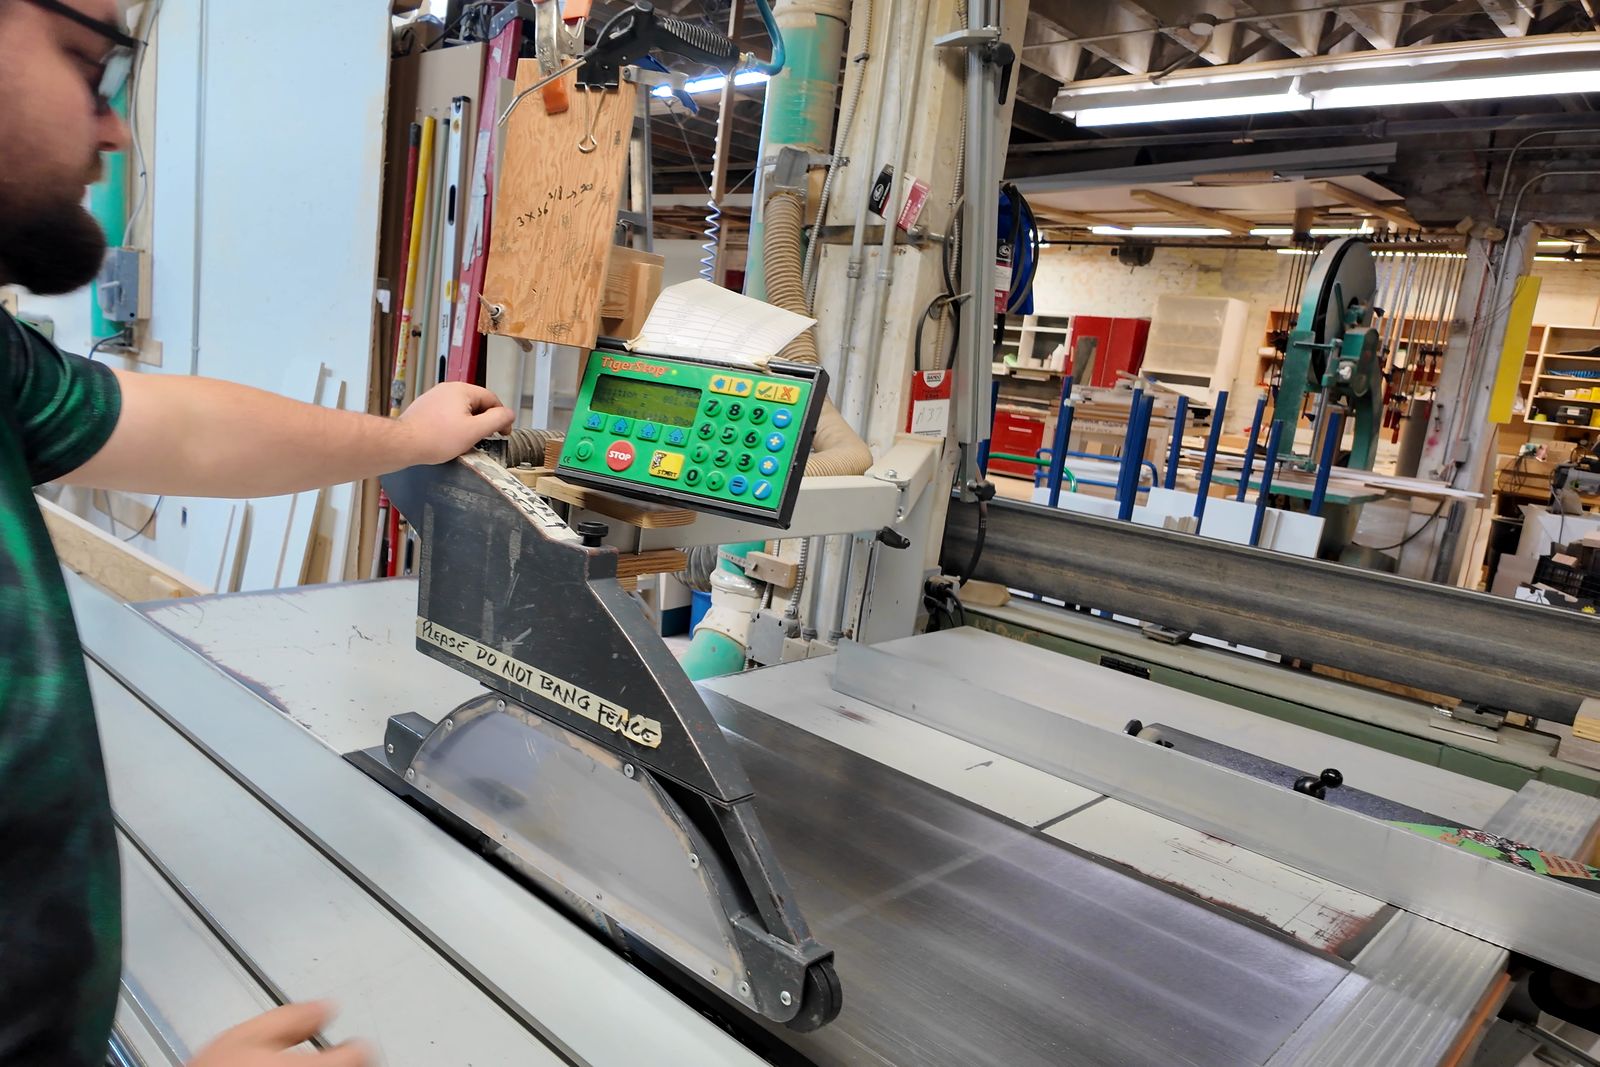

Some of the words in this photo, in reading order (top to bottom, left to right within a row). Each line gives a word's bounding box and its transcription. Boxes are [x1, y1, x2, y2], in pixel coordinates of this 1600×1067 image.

[601, 356, 668, 378] TigerStop
[706, 400, 719, 412] 7
[728, 404, 741, 416] 8
[752, 408, 764, 420] 9
[700, 423, 711, 435] 4
[722, 427, 734, 439] 5
[744, 431, 756, 443] 6
[608, 450, 632, 462] STOP
[715, 449, 728, 462] 2
[739, 454, 751, 466] 3
[656, 469, 679, 478] START
[685, 468, 699, 481] 0
[422, 621, 470, 653] PLEASE
[476, 645, 498, 667] DO
[502, 659, 534, 686] NOT
[539, 674, 591, 711] BANG
[597, 702, 659, 743] FENCE
